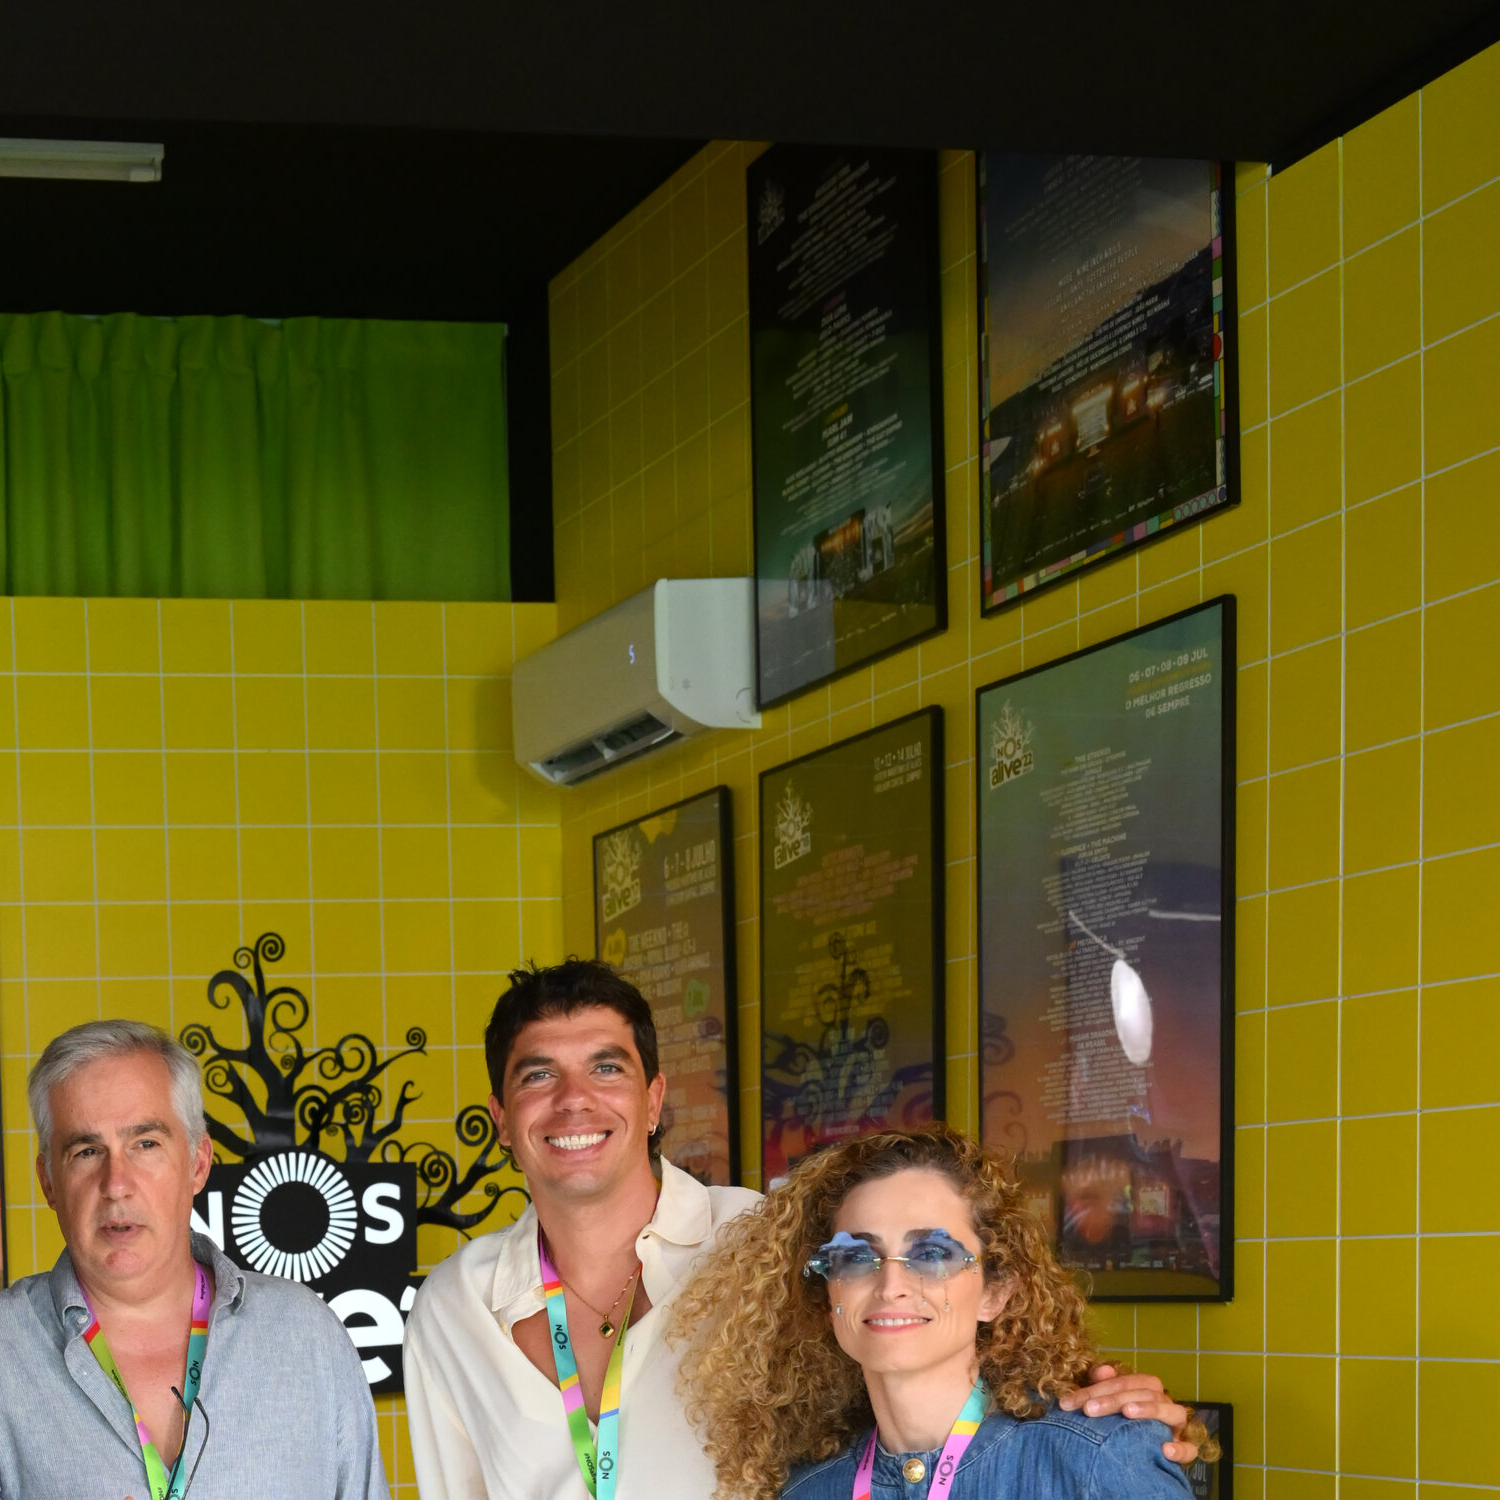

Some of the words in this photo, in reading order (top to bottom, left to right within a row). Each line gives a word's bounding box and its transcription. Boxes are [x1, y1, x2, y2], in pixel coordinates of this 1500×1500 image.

[1191, 647, 1208, 662] JUL
[1133, 688, 1166, 707] MELHOR
[1167, 673, 1212, 696] REGRESSO
[1145, 706, 1156, 719] DE
[1157, 695, 1190, 715] SEMPRE
[553, 1324, 569, 1351] NOS
[188, 1360, 201, 1386] NOS
[598, 1450, 615, 1480] NOS
[938, 1454, 955, 1486] NOS
